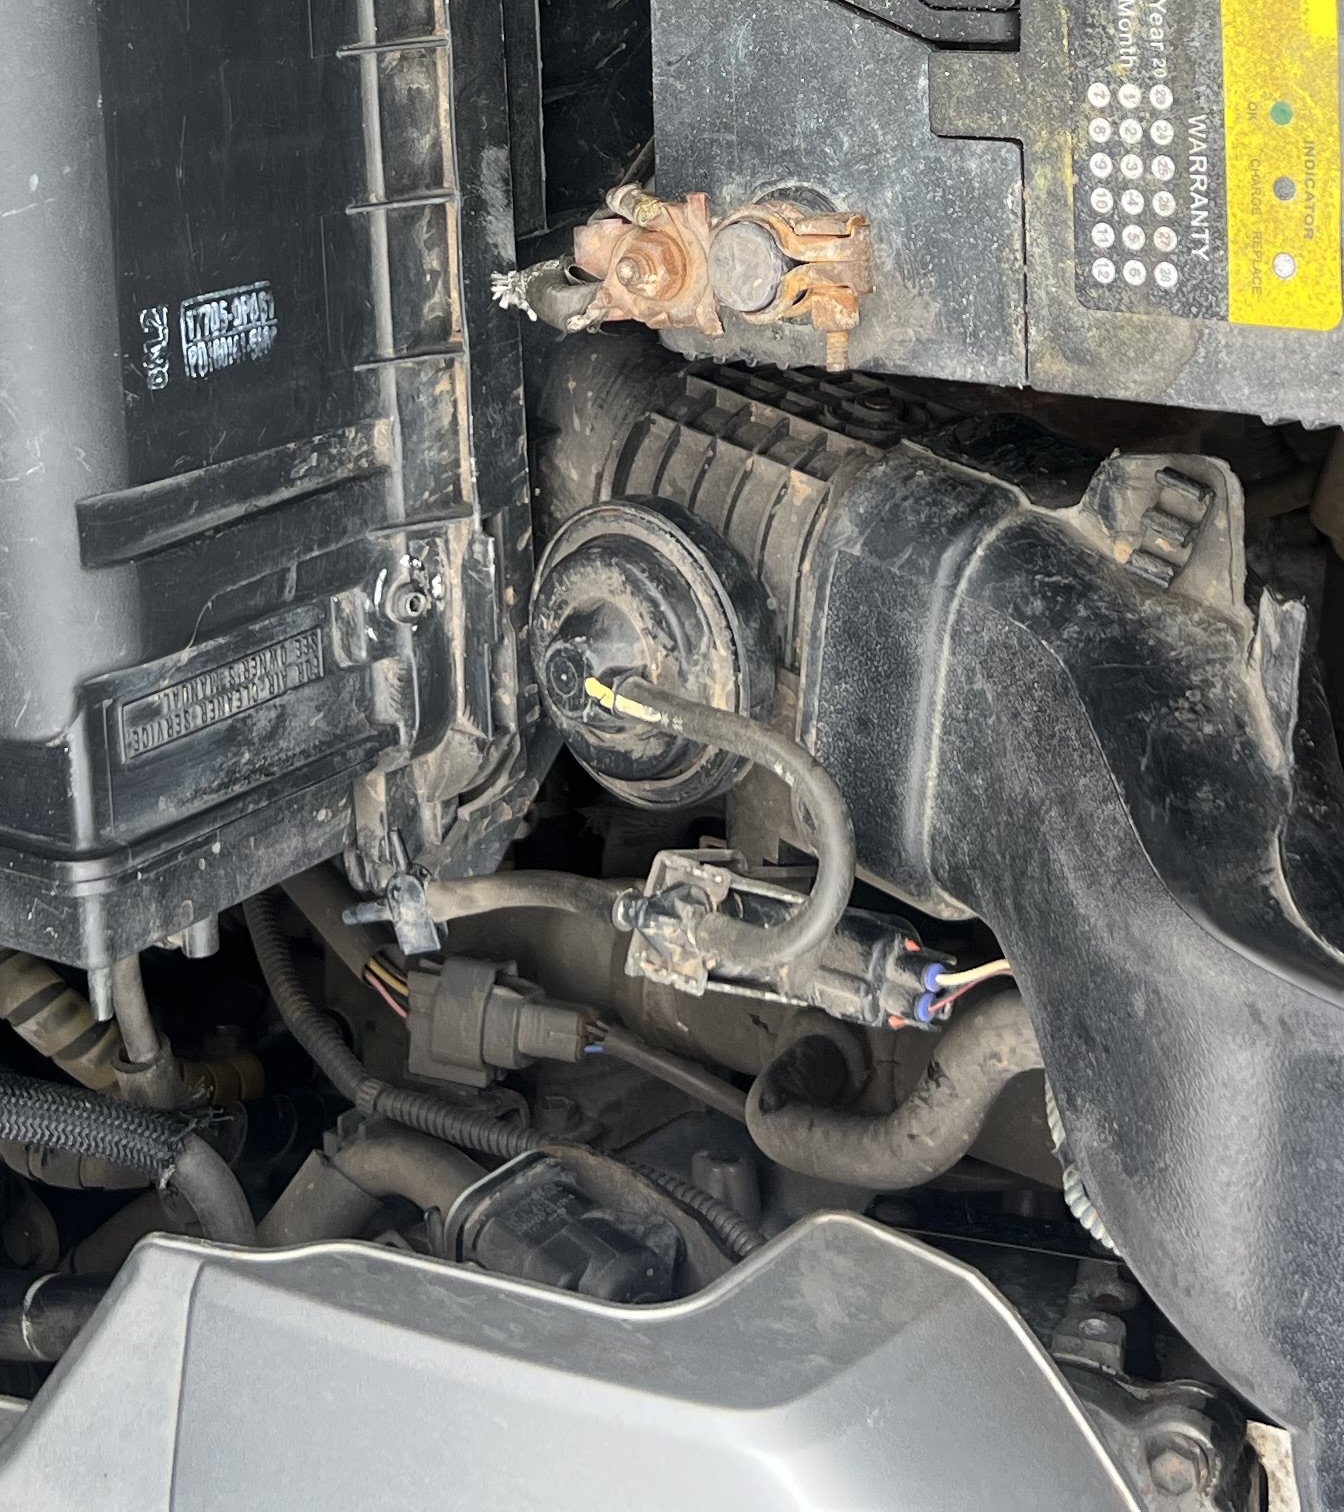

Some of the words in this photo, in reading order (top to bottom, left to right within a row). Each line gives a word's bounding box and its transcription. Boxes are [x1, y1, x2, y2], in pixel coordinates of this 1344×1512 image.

[1151, 58, 1166, 78] 20
[1247, 102, 1257, 121] OK
[1188, 114, 1209, 261] WARRANTY
[1250, 158, 1263, 216] CHARGE
[1303, 140, 1316, 240] INDICATOR
[1251, 231, 1263, 295] REPLACE
[227, 644, 287, 688] OWNER'S
[294, 631, 318, 658] SEE
[266, 670, 288, 695] AIR
[295, 656, 320, 683] FOR
[157, 671, 218, 714] MANUAL.
[199, 682, 258, 725] CLEANER
